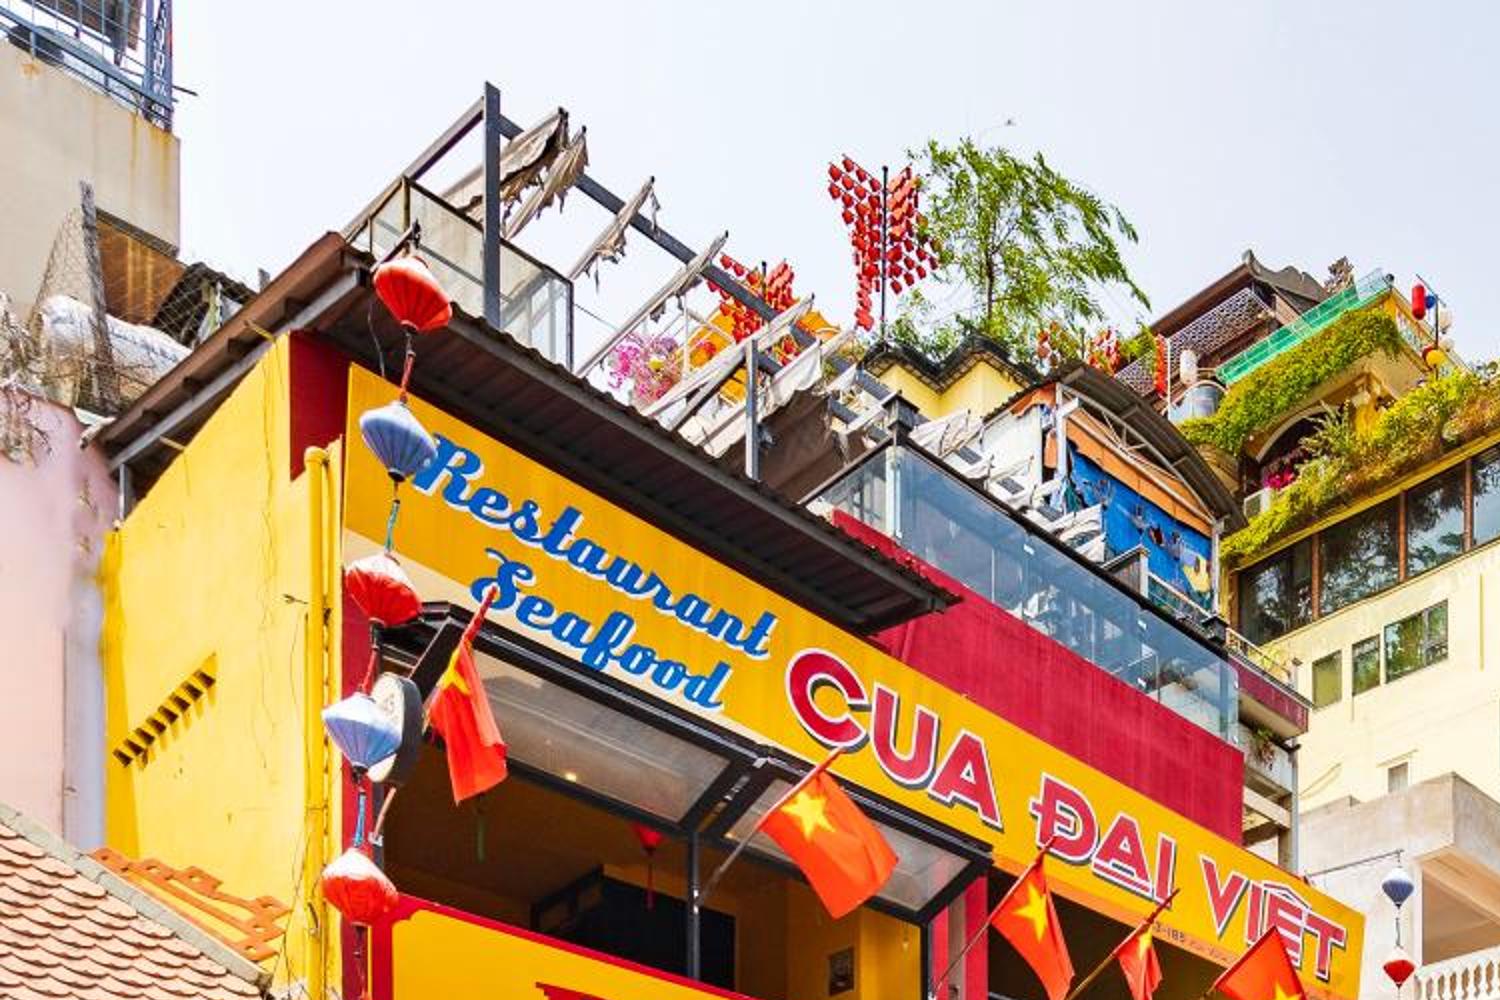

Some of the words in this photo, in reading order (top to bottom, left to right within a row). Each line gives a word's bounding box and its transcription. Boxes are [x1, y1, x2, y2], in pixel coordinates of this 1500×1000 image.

[413, 432, 778, 659] Restaurant
[470, 547, 732, 712] Seafood
[785, 647, 1004, 832] CUA
